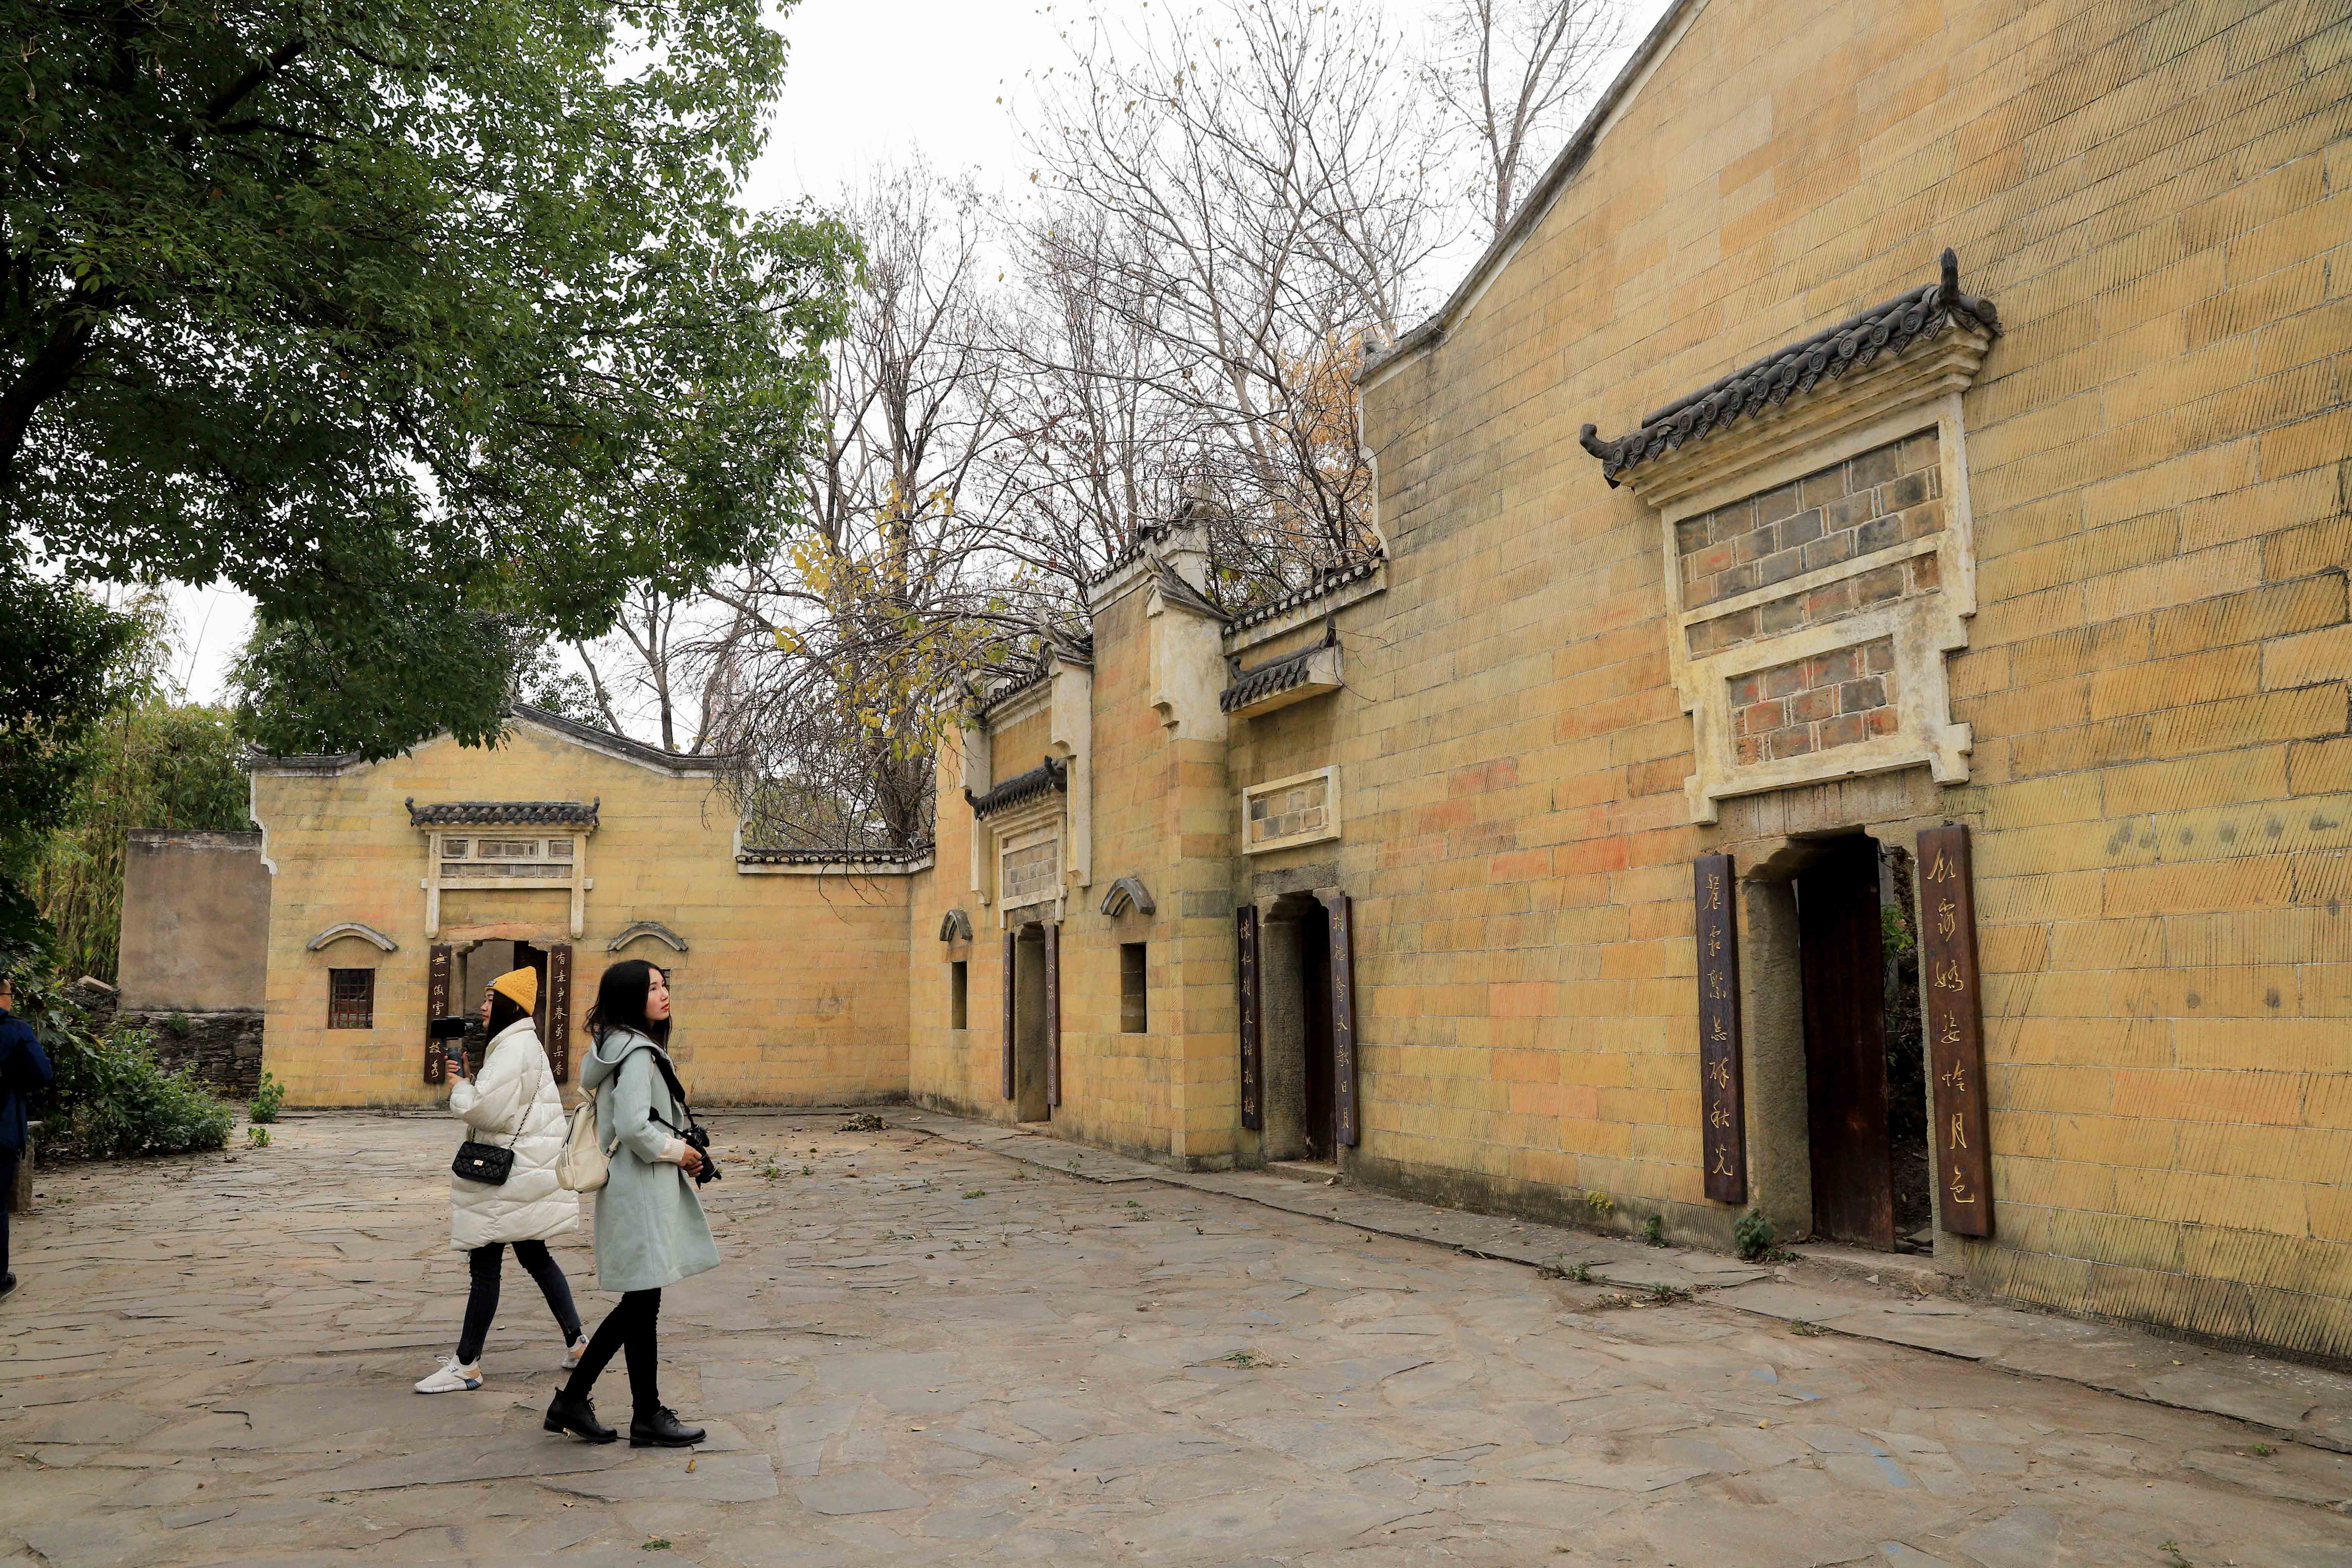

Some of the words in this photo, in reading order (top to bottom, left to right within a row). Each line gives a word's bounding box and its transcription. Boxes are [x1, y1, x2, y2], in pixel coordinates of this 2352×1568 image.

[429, 954, 448, 1078] 無心傲雪枝秀
